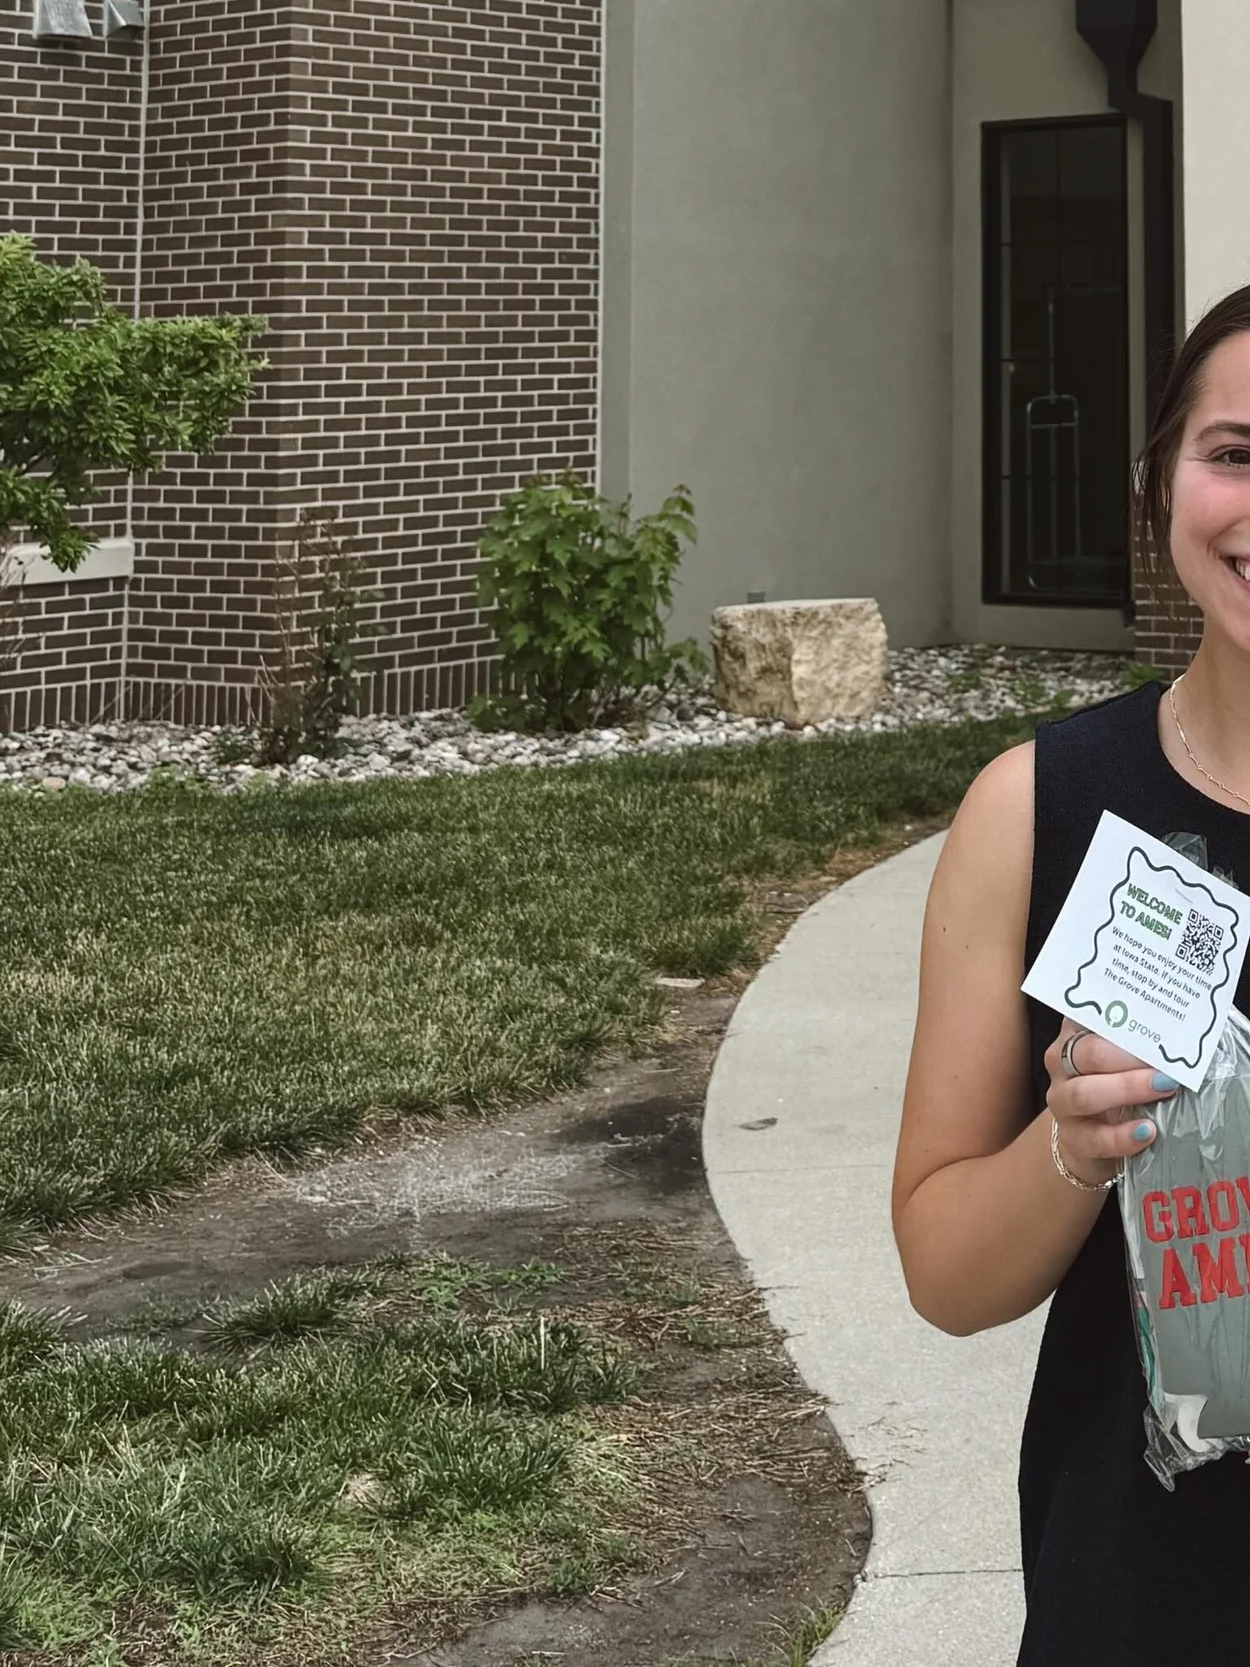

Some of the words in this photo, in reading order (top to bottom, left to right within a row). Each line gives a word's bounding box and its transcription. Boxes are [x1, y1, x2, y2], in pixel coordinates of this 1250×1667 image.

[1119, 900, 1137, 919] TO
[1134, 911, 1173, 940] AMES!
[1126, 883, 1184, 925] WELCOME
[1112, 925, 1124, 937] We
[1124, 931, 1143, 950] hope
[1143, 945, 1157, 959] you
[1157, 952, 1177, 971] enjoy
[1177, 965, 1196, 980] your
[1195, 973, 1212, 991] time
[1112, 957, 1130, 975] time,
[1130, 970, 1148, 985] stop
[1148, 979, 1158, 991] by
[1158, 986, 1173, 998] and
[1173, 992, 1190, 1008] tour
[1113, 944, 1121, 953] at
[1122, 948, 1139, 963] Iowa
[1167, 977, 1182, 991] you
[1183, 983, 1201, 999] have
[1104, 968, 1117, 981] The
[1118, 976, 1140, 994] Grove
[1140, 990, 1186, 1022] Apartments!
[1127, 1019, 1162, 1043] grove
